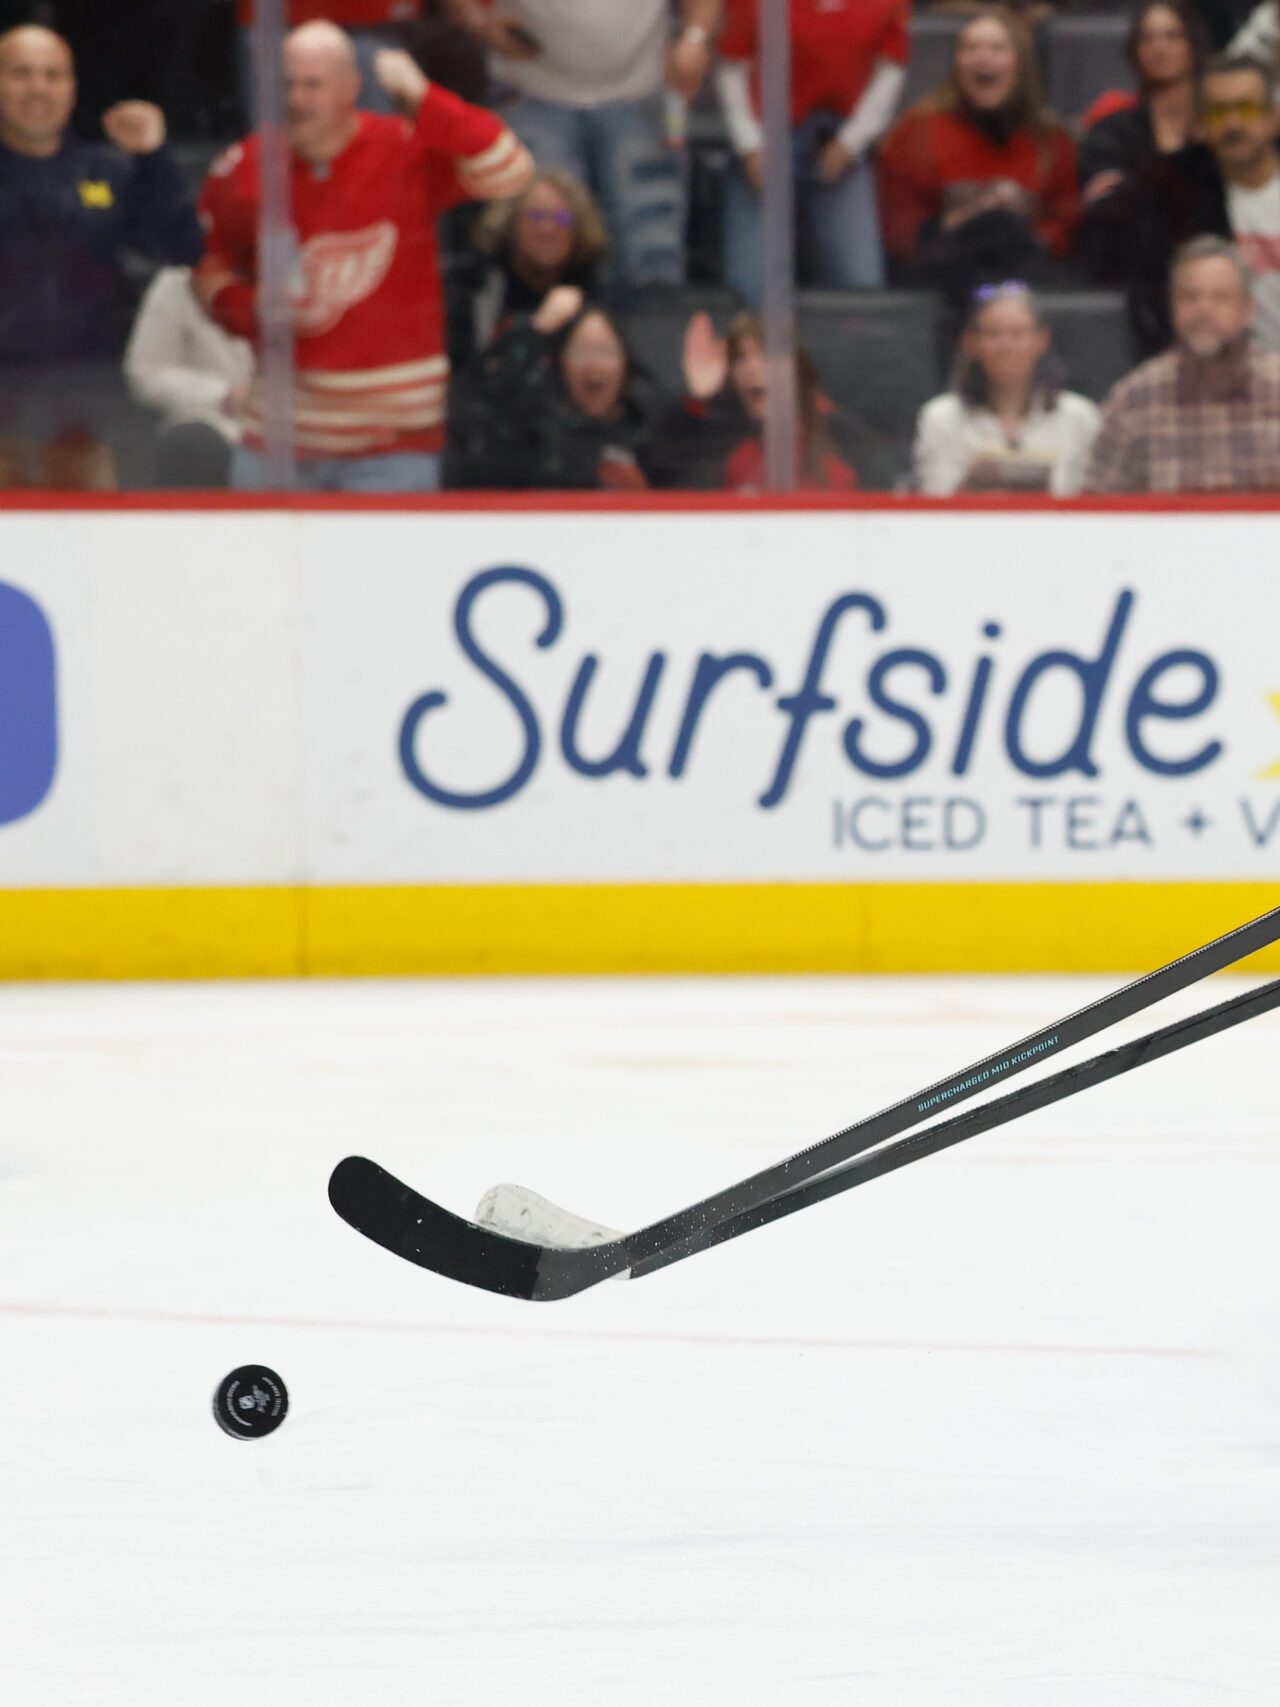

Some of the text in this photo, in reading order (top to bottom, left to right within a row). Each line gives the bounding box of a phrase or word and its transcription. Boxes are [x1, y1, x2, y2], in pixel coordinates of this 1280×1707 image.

[399, 565, 1223, 811] Surfside
[832, 796, 988, 852] ICED
[1014, 796, 1155, 852] TEA
[1182, 805, 1212, 837] +
[917, 1035, 1060, 1112] SUPERCHARGED MID KICKPOINT
